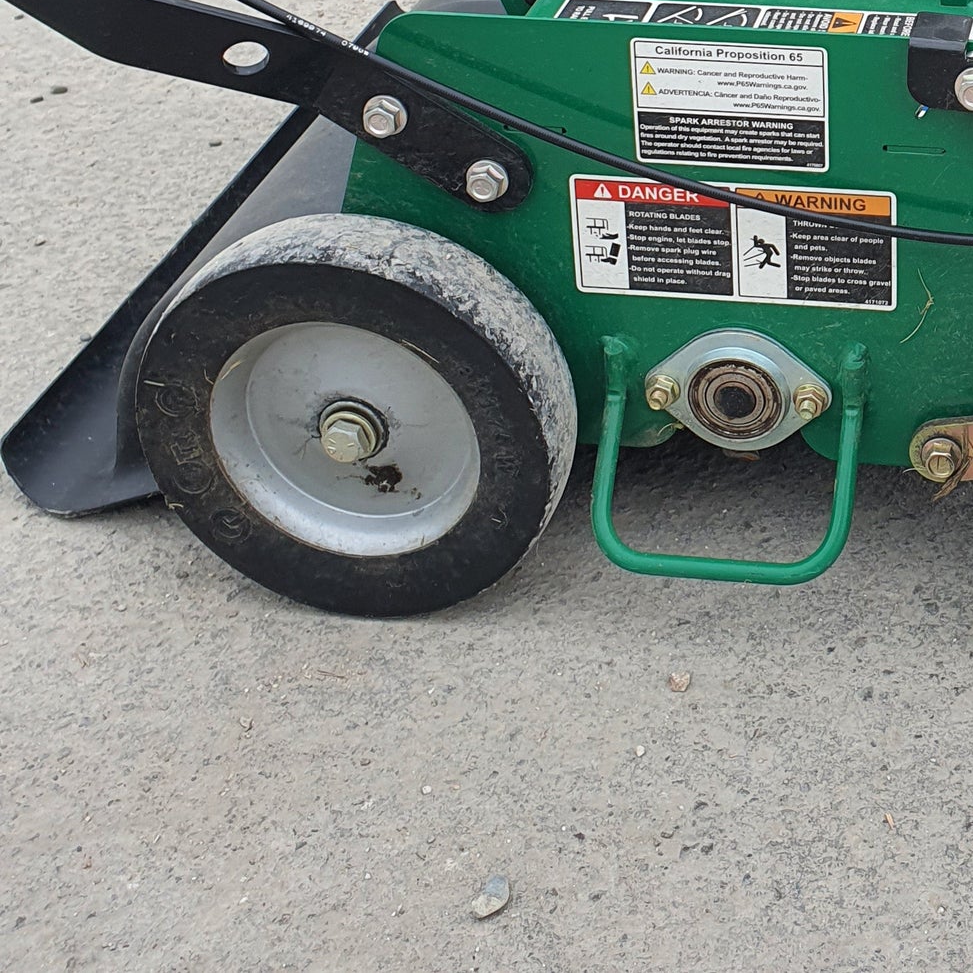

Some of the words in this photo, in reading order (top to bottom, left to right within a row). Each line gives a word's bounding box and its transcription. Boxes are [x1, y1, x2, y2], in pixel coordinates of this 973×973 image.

[655, 46, 712, 57] California
[716, 49, 785, 62] Proposition
[789, 53, 803, 62] 65
[657, 67, 696, 76] WARNING:
[739, 71, 784, 81] Reproductive
[669, 116, 699, 125] SPARK
[701, 119, 749, 128] ARRESTOR
[751, 121, 794, 130] WARNING
[618, 185, 699, 203] DANGER
[775, 193, 866, 211] WARNING
[629, 211, 667, 219] ROTATING
[669, 213, 701, 221] BLADES
[688, 237, 711, 245] blades
[859, 237, 884, 245] people
